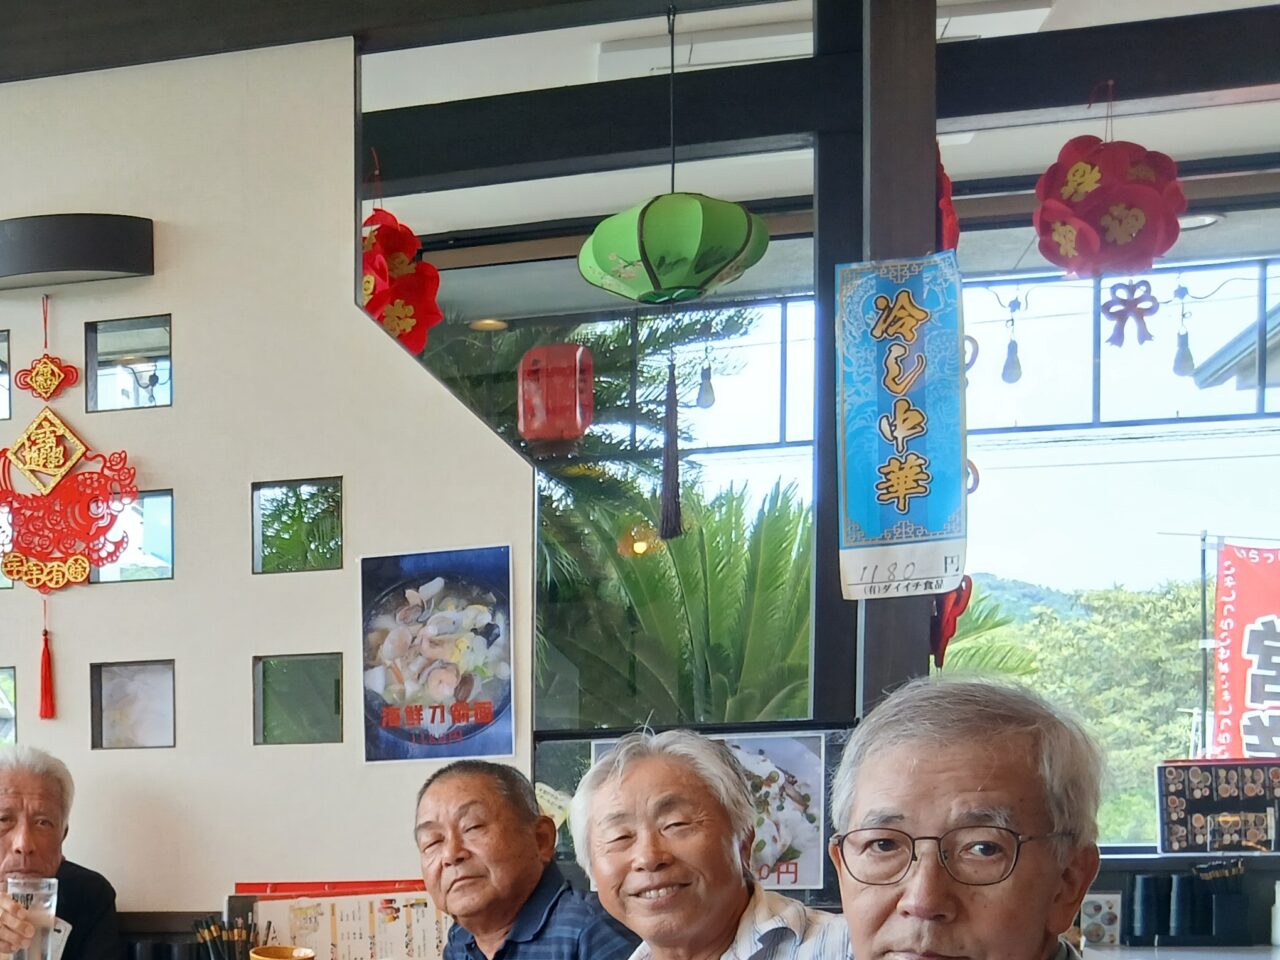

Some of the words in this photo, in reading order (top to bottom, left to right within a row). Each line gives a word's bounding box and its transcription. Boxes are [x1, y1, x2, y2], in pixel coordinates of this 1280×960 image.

[869, 289, 933, 514] 冷し中華
[860, 561, 916, 583] 1180
[943, 554, 960, 574] 円
[1233, 547, 1280, 564] いらっ
